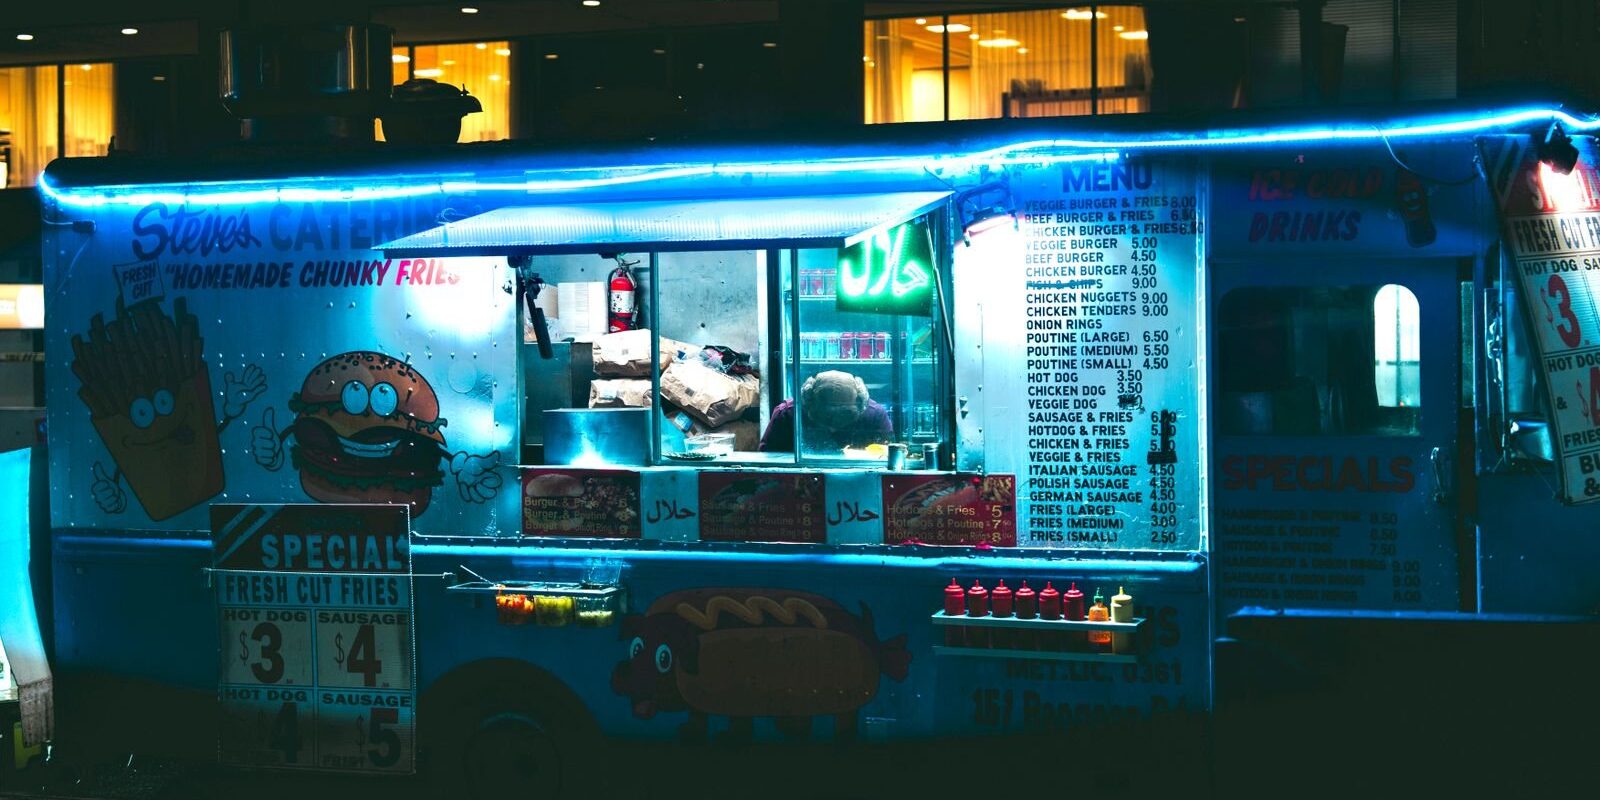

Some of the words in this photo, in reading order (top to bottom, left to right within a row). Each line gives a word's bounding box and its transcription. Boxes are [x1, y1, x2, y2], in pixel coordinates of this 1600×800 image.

[1062, 162, 1153, 193] MENU
[1248, 170, 1296, 201] ICE
[1306, 167, 1383, 199] COLD
[1025, 199, 1065, 211] VEGGIE
[1070, 198, 1117, 210] BURGER
[1121, 198, 1130, 208] &
[1135, 196, 1168, 208] FRIES
[1025, 213, 1053, 224] BEEF
[1057, 212, 1101, 223] BURGER
[1108, 212, 1117, 222] &
[1121, 210, 1154, 221] FRIES
[1171, 208, 1197, 221] 6.0
[132, 202, 261, 261] Steve's
[1025, 226, 1075, 237] HICKEN
[1080, 224, 1126, 236] BURGER
[1131, 224, 1140, 235] &
[1144, 223, 1178, 234] FRIES
[1180, 222, 1203, 235] 6.0
[1248, 209, 1361, 242] DRINKS
[1515, 219, 1561, 254] FRESH
[1561, 218, 1587, 249] CUT
[1025, 240, 1066, 250] VEGGIE
[1071, 238, 1118, 249] BURGER
[1131, 237, 1158, 249] 5.00
[841, 223, 930, 298] حلال
[1025, 254, 1053, 264] BEEF
[1057, 252, 1104, 263] BURGER
[1131, 250, 1157, 262] 4.50
[123, 264, 157, 284] FRESH
[299, 258, 392, 287] CHUNKY
[1025, 267, 1076, 277] CHICKEN
[1080, 265, 1127, 276] BURGER
[1131, 264, 1157, 276] 4.50
[1524, 261, 1549, 276] HOT
[1552, 259, 1578, 273] DOG
[1132, 277, 1157, 288] 9.00
[132, 283, 154, 299] CUT
[1026, 294, 1077, 304] CHICKEN
[1081, 292, 1137, 303] NUGGETS
[1141, 292, 1168, 304] 9.00
[1026, 306, 1077, 317] CHICKEN
[1081, 305, 1137, 316] TENDERS
[1142, 305, 1169, 316] 9.00
[1026, 320, 1062, 330] ONION
[1066, 319, 1103, 330] RINGS
[1027, 333, 1077, 343] POUTINE
[1080, 332, 1130, 343] (LARGE)
[1142, 330, 1169, 342] 6.50
[1027, 346, 1077, 357] POUTINE
[1081, 345, 1138, 357] (MEDIUM)
[1143, 344, 1170, 356] 5.50
[1027, 360, 1078, 370] POUTINE
[1081, 359, 1132, 370] (SMALL)
[1143, 357, 1169, 369] 4.50
[1549, 358, 1574, 373] HOT
[1027, 373, 1051, 383] HOT
[1054, 373, 1079, 383] DOG
[1117, 369, 1143, 381] 3.50
[1027, 386, 1078, 396] CHICKEN
[1082, 386, 1106, 396] DOG
[1117, 382, 1143, 394] 3.50
[1028, 399, 1070, 410] VEGGIE
[1073, 399, 1098, 410] DOG
[1556, 396, 1567, 410] &
[1028, 412, 1083, 423] SAUSAGE
[1086, 412, 1096, 422] &
[1100, 412, 1134, 422] FRIES
[1151, 411, 1177, 423] 6.0
[1028, 426, 1076, 436] HOTDOG
[1080, 426, 1089, 436] &
[1092, 425, 1126, 436] FRIES
[1151, 425, 1177, 437] 5.0
[1028, 439, 1079, 449] CHICKEN
[1083, 439, 1092, 449] &
[1096, 439, 1130, 449] FRIES
[1150, 440, 1176, 452] 5.0
[1029, 452, 1071, 462] VEGGIE
[1074, 452, 1083, 462] &
[1087, 452, 1120, 462] FRIES
[1029, 465, 1078, 475] ITALIAN
[1081, 465, 1137, 476] SAUSAGE
[1149, 464, 1175, 476] 4.50
[1222, 455, 1415, 493] SPECIALS
[1029, 479, 1071, 489] POLISH
[1074, 479, 1129, 490] SAUSAGE
[1149, 477, 1175, 489] 4.50
[524, 497, 557, 508] Burger
[1029, 492, 1083, 502] GERMAN
[1087, 492, 1143, 503] SAUSAGE
[1150, 489, 1175, 501] 4.50
[646, 500, 697, 524] حلال
[828, 501, 879, 526] حلال
[936, 505, 944, 515] &
[947, 505, 976, 516] Fries
[1029, 505, 1062, 515] FRIES
[1066, 504, 1115, 516] (LARGE)
[1150, 502, 1176, 514] 4.00
[947, 519, 984, 530] Poutine
[1030, 518, 1063, 528] FRIES
[1067, 518, 1124, 529] (MEDIUM)
[1151, 516, 1176, 527] 3.00
[1030, 531, 1063, 541] FRIES
[1067, 531, 1118, 542] (SMALL)
[1151, 532, 1176, 543] 2.50
[225, 575, 290, 605] FRESH
[300, 576, 330, 605] CUT
[341, 577, 399, 606] FRIES
[224, 609, 261, 622] HOT
[266, 609, 308, 623] DOG
[318, 612, 410, 625] SAUSAGE
[1122, 661, 1184, 686] 0361
[224, 689, 261, 701] HOT
[267, 690, 309, 703] DOG
[321, 693, 412, 708] SAUSAGE
